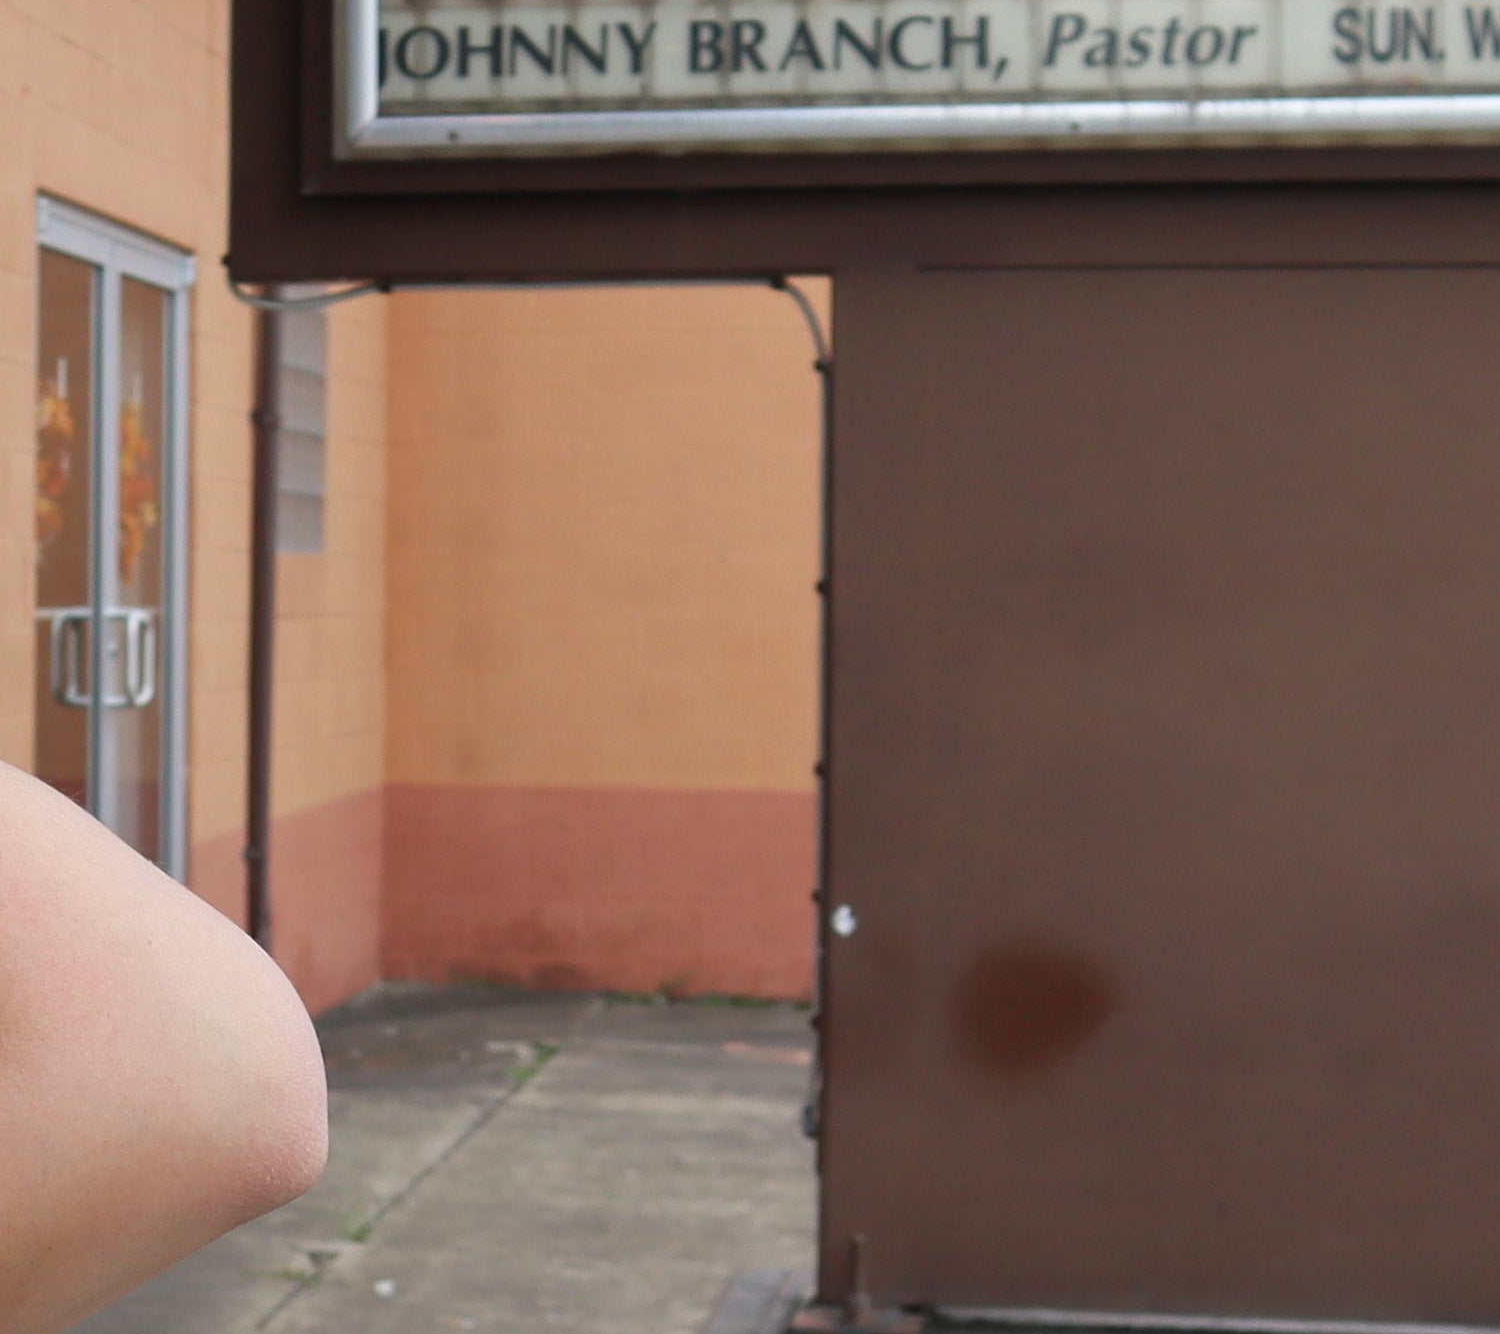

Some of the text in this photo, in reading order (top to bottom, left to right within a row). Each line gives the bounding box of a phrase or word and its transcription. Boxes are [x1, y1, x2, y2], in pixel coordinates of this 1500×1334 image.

[687, 14, 1011, 81] BRANCH,
[1043, 13, 1257, 67] Pastor
[1332, 6, 1445, 64] SUN.
